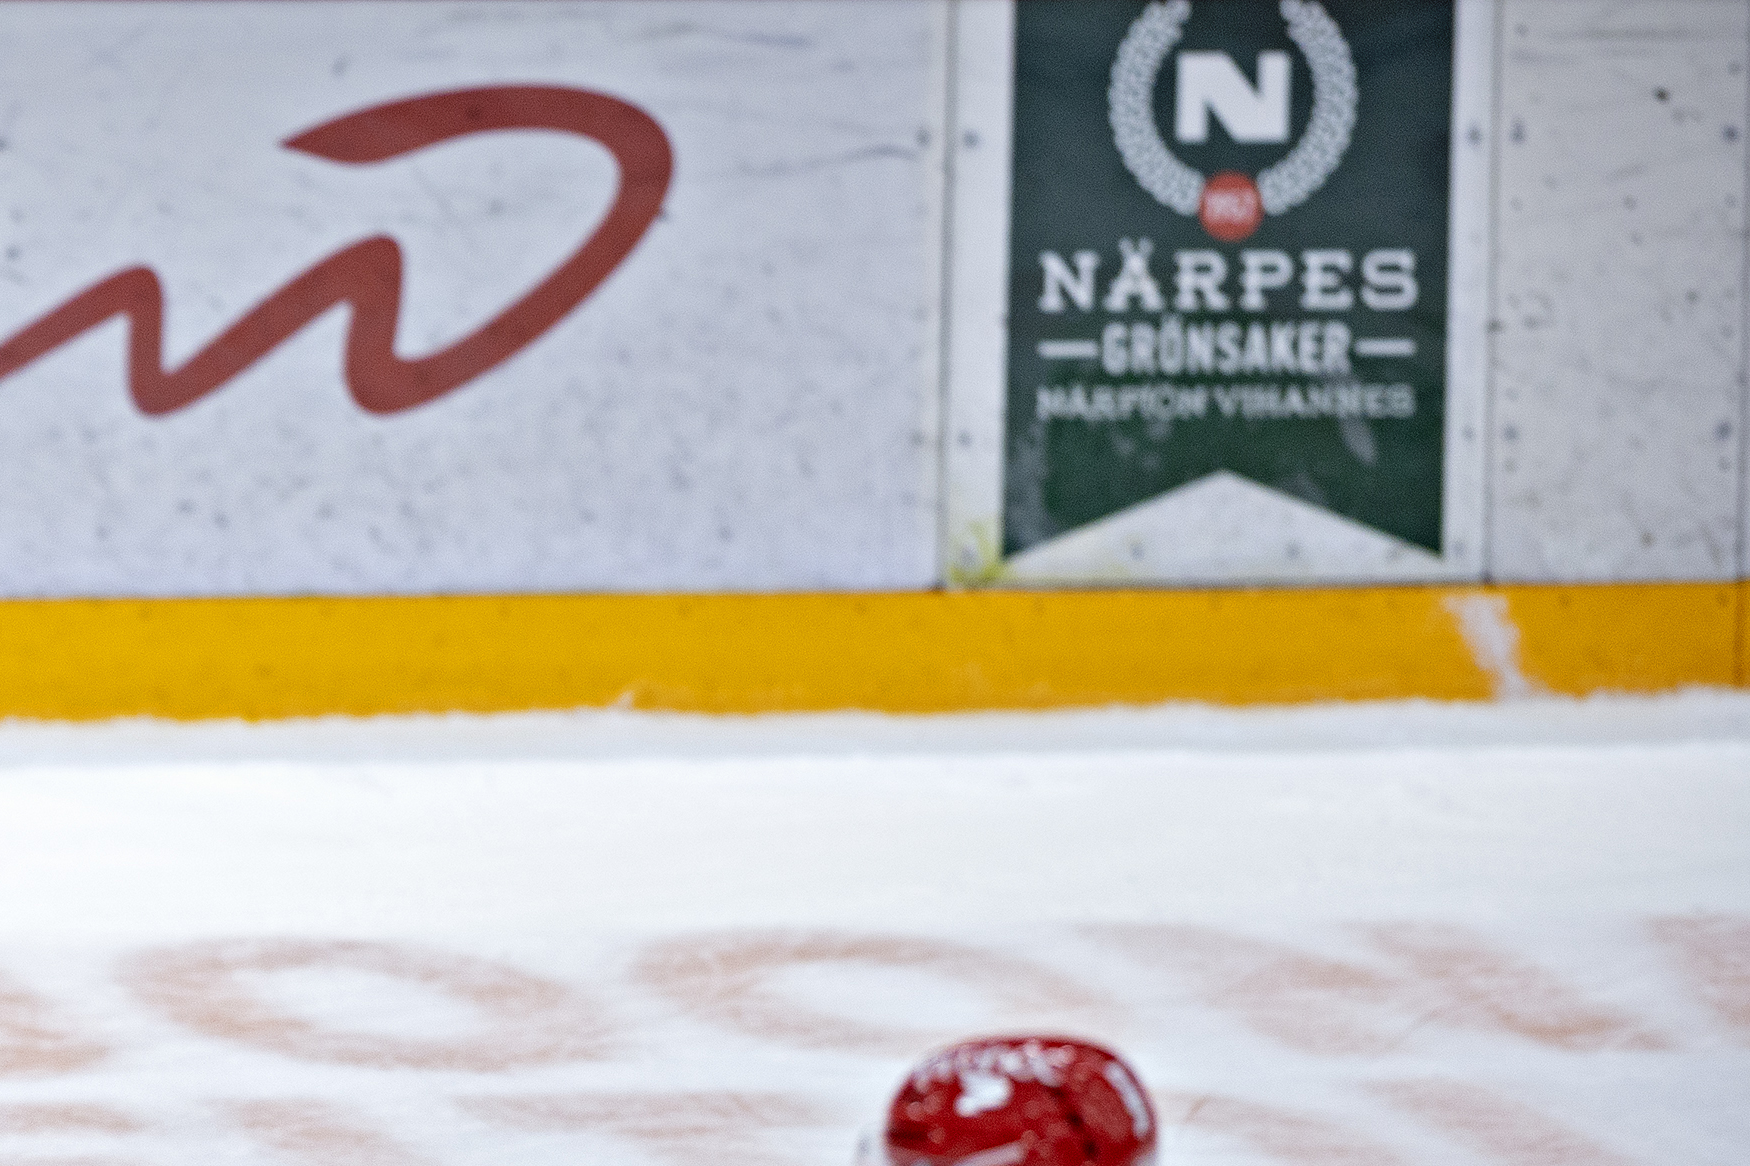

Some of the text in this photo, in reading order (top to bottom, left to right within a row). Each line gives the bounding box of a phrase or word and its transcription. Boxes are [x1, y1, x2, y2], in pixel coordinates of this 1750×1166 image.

[1174, 48, 1292, 144] N
[1037, 238, 1421, 313] NÄRPES
[1100, 314, 1355, 376] GRÖNSAKER
